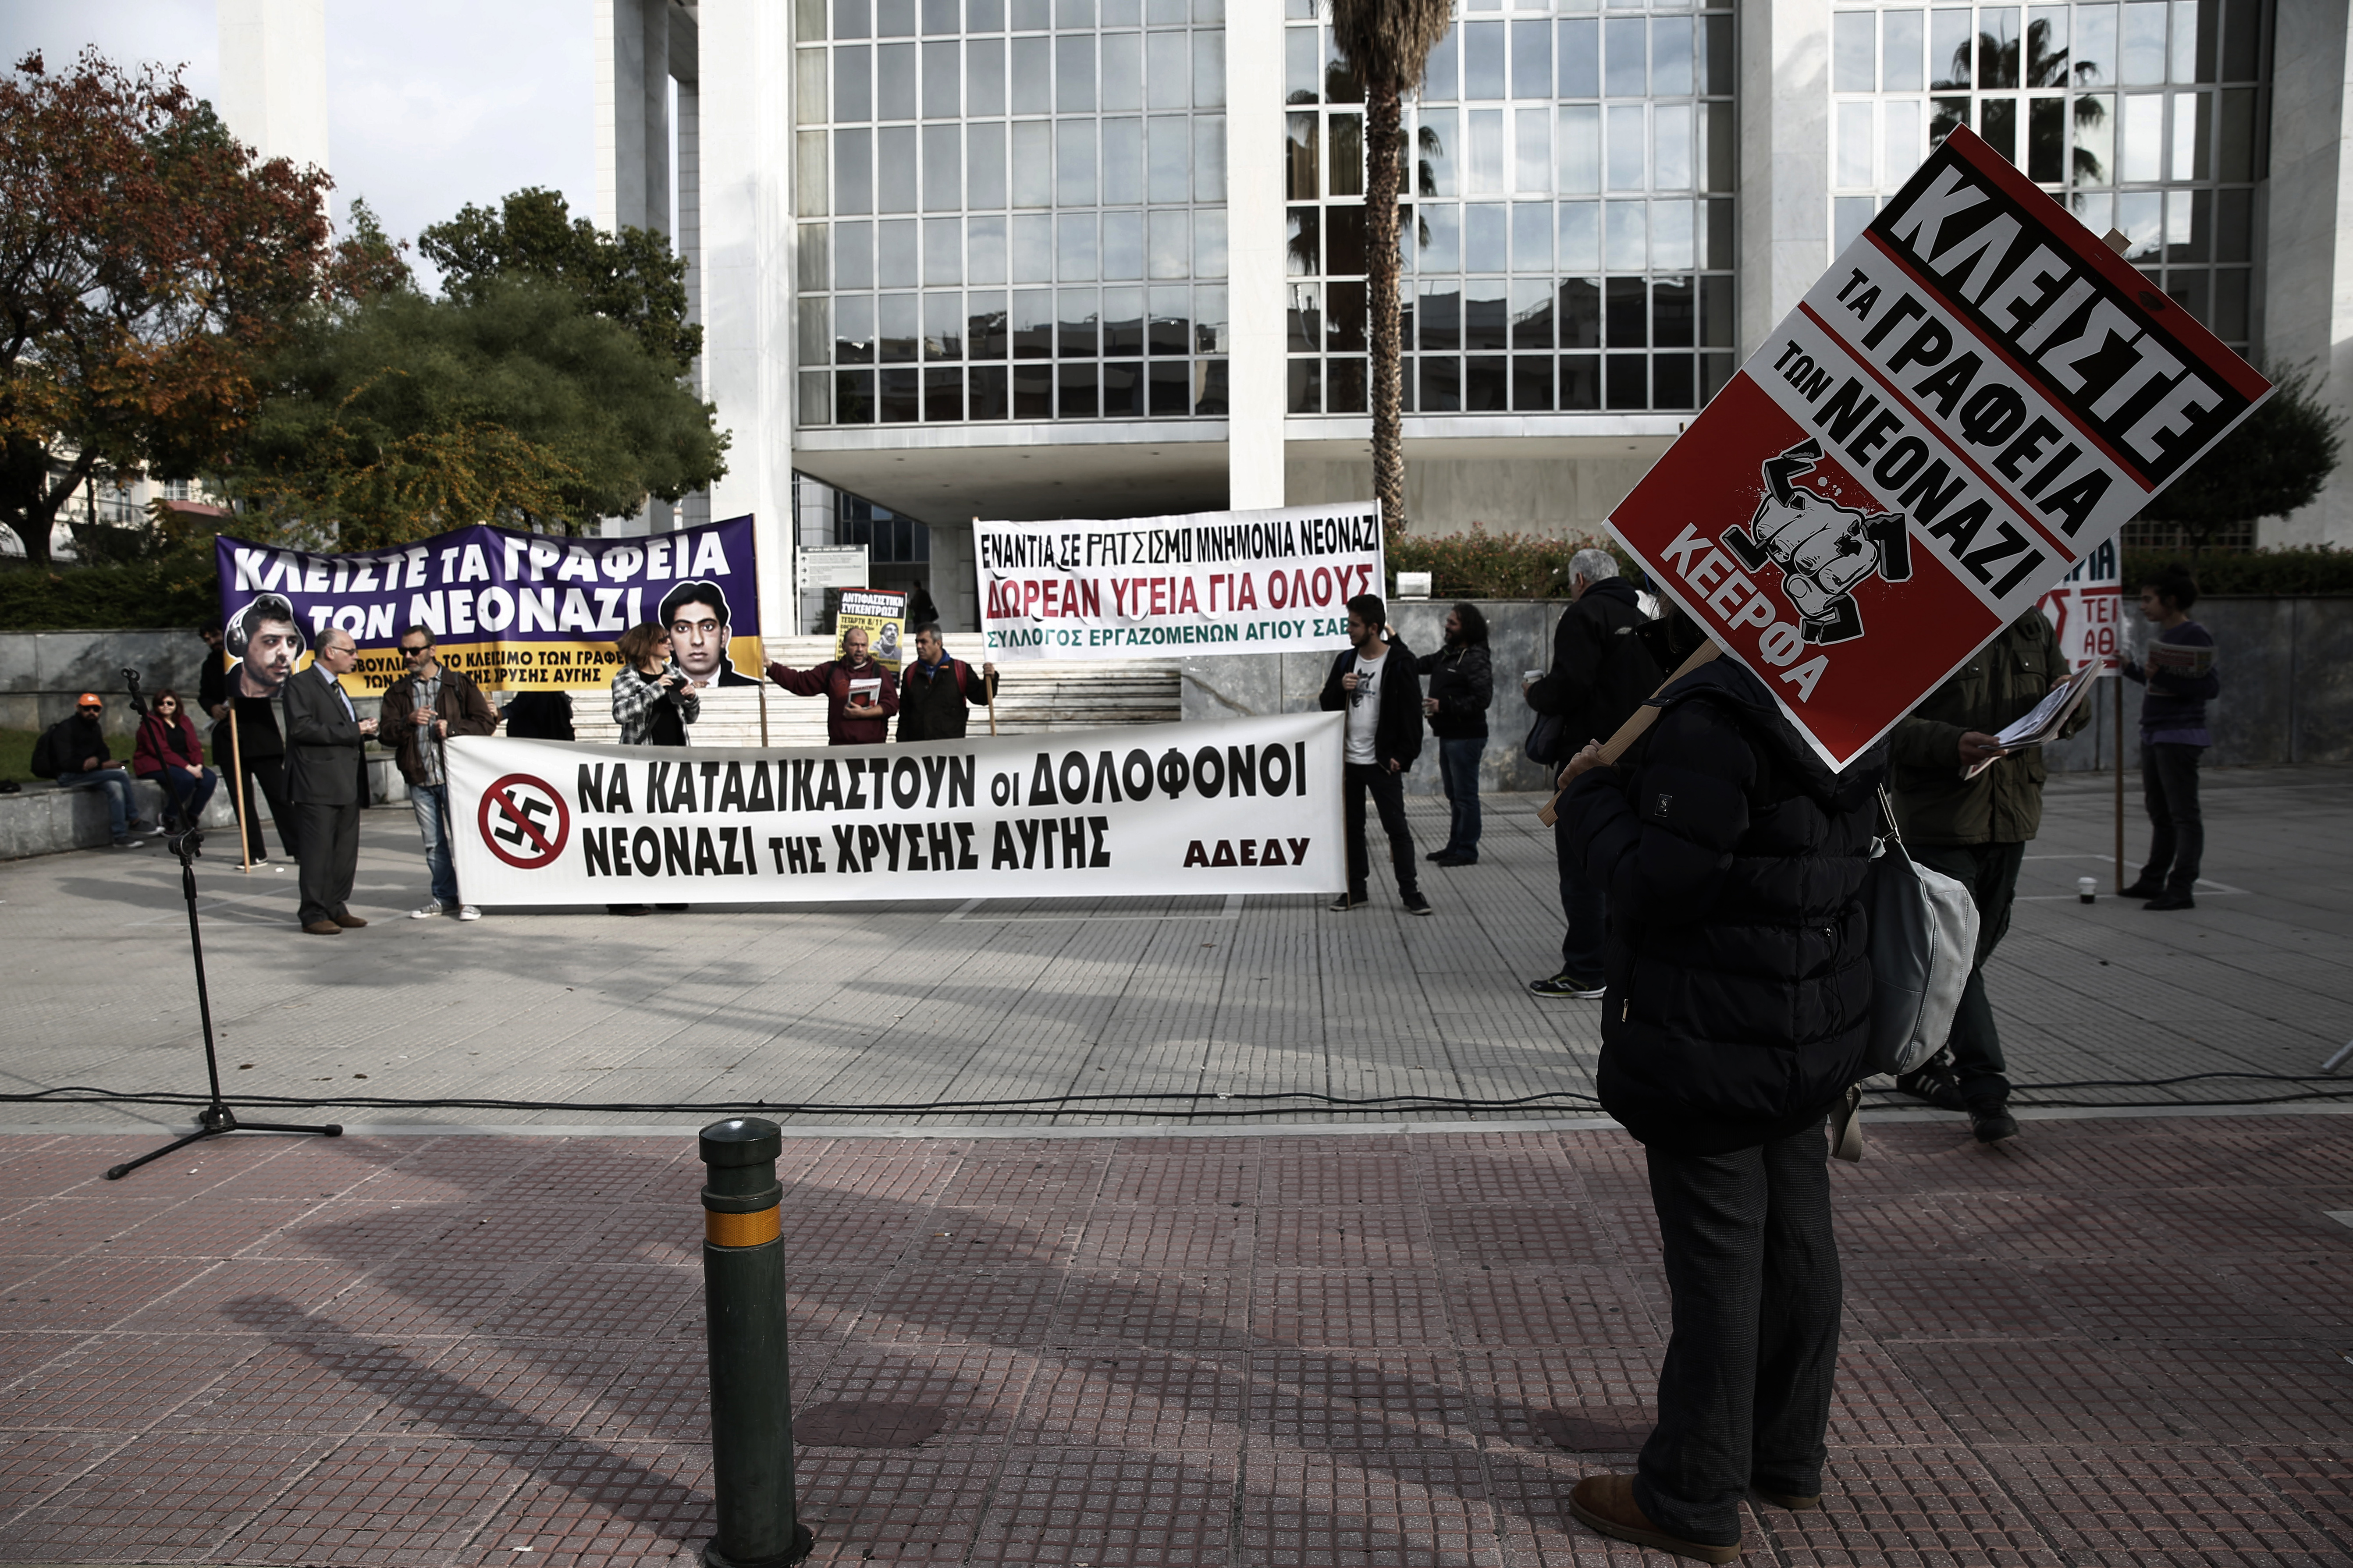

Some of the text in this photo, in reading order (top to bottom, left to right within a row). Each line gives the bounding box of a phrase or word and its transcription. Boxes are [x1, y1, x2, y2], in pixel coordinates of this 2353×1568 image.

[1890, 163, 2224, 464] ΚΛΕΙΣΤΕ
[1836, 267, 2113, 538] ΤΑ ΓΡΑΦΕΙΑ
[1773, 340, 2045, 600] ΤΩΝ ΝΕΟΝΑΖΙ
[234, 531, 731, 593] ΚΛΕΙΣΤΕ ΤΑ ΓΡΑΦΕΙΑ
[981, 514, 1379, 568] ΕΝΑΝΤΙΑ ΣΕ ΡΑΤΣΙΣΜΟ ΜΝΗΜΟΝΙΑ ΝΕΟΝΑΖΙ
[308, 586, 642, 640] ΤΩΝ ΝΕΟΝΑΖΙ
[841, 603, 899, 617] ΣΥΓΚΕΝΤΡΩΣΗ
[842, 592, 903, 607] ΑΝΤΙΦΑΣΙΣΤΙΚΗ
[987, 564, 1373, 619] ΔΩΡΕΑΝ ΥΓΕΙΑ ΓΙΑ ΟΛΟΥΣ
[1660, 523, 1830, 703] ΚΕΕΡΦΑ
[2083, 598, 2118, 623] ΤΕΙ
[443, 654, 461, 668] ΤΟ
[466, 651, 533, 667] ΚΛΕΙΣΙΜΟ
[539, 651, 571, 665] ΤΩΝ
[988, 617, 1349, 648] ΣΥΛΛΟΓΟΣ ΕΡΓΑΖΟΜΕΝΩΝ ΑΓΙΟΥ ΣΑΒ
[495, 669, 548, 683] ΧΡΥΣΗΣ
[553, 668, 601, 683] ΑΥΓΗΣ
[578, 762, 633, 813] ΝΑ
[647, 754, 975, 814] ΚΑΤΑΔΙΚΑΣΤΟΥΝ
[1028, 741, 1306, 806] ΔΟΛΟΦΟΝΟΙ
[582, 816, 1111, 877] ΝΕΟΝΑΖΙ ΤΗΣ ΧΡΥΣΗΣ ΑΥΓΗΣ
[1183, 837, 1311, 868] ΑΔΕΔΥ
